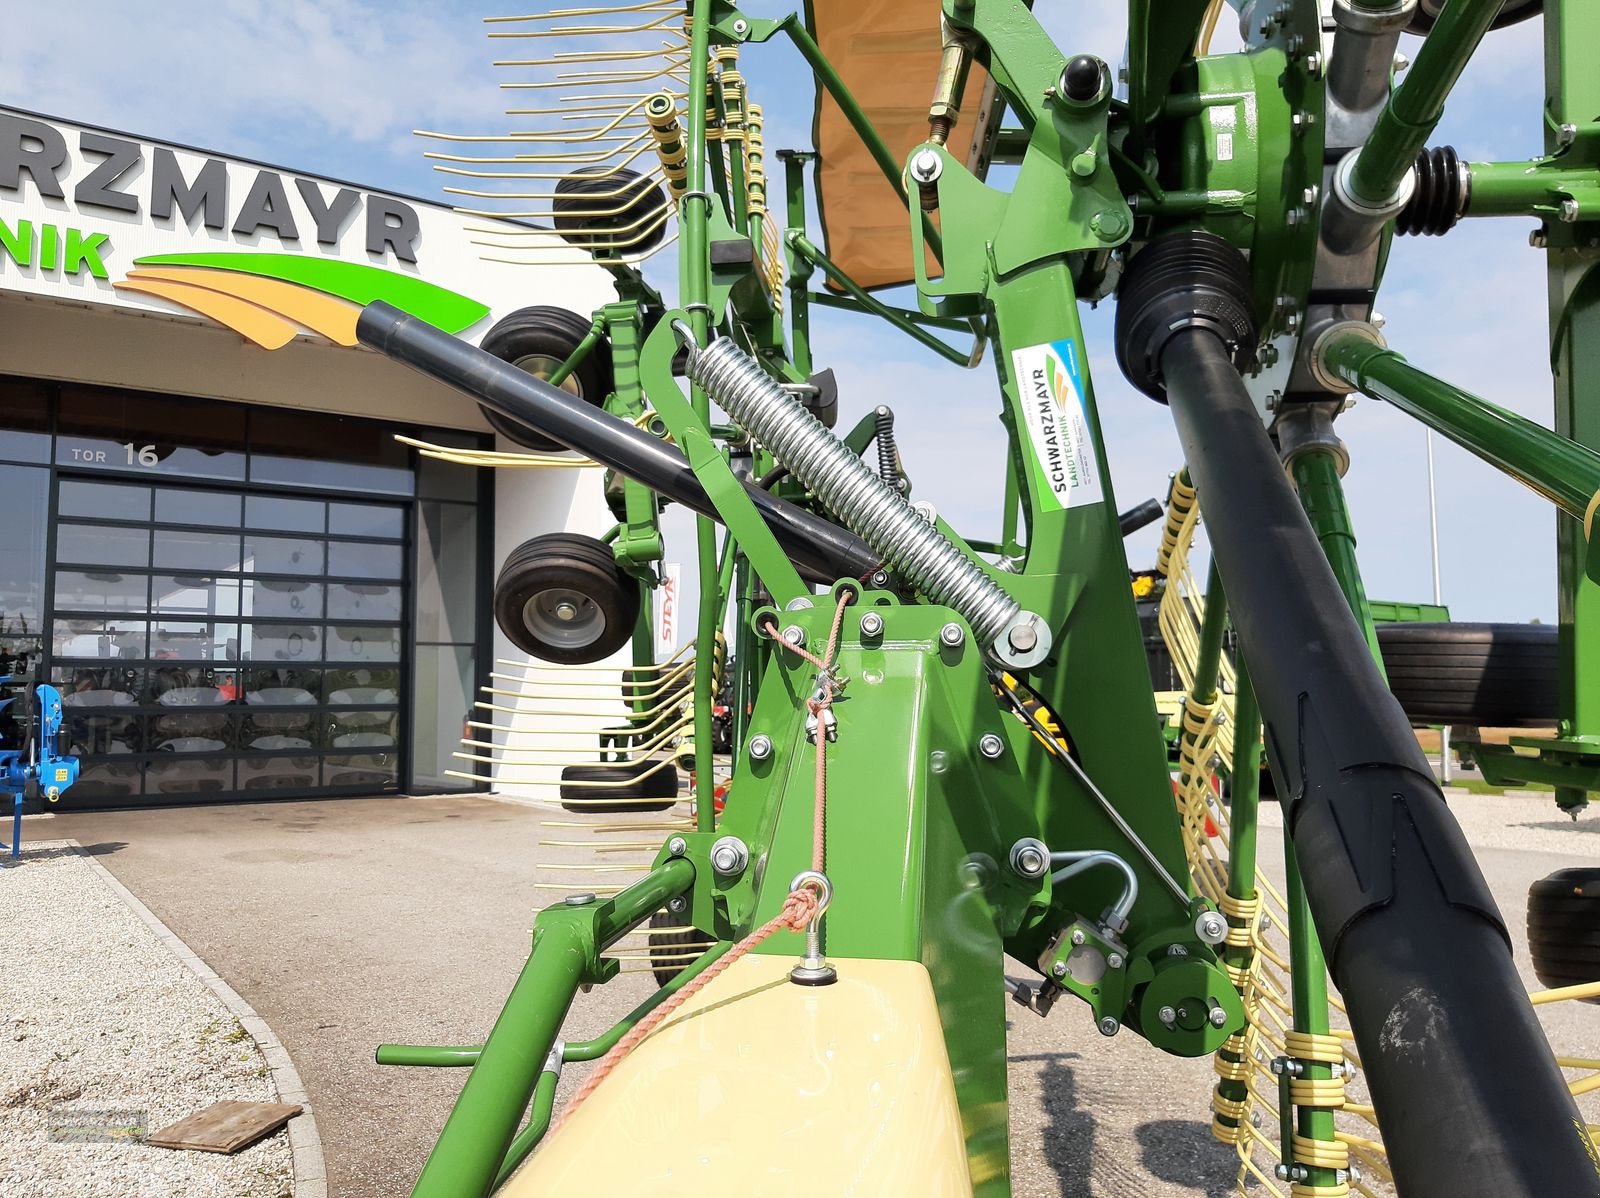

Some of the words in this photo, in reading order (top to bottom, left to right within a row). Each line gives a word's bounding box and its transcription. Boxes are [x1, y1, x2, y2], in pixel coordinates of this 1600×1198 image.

[0, 113, 420, 264] RZMAYR
[0, 216, 110, 280] NIK
[71, 448, 107, 463] TOR
[123, 442, 159, 467] 16
[1032, 368, 1067, 493] SCHWARZMAYR
[1057, 415, 1079, 488] LANDTECHNIK
